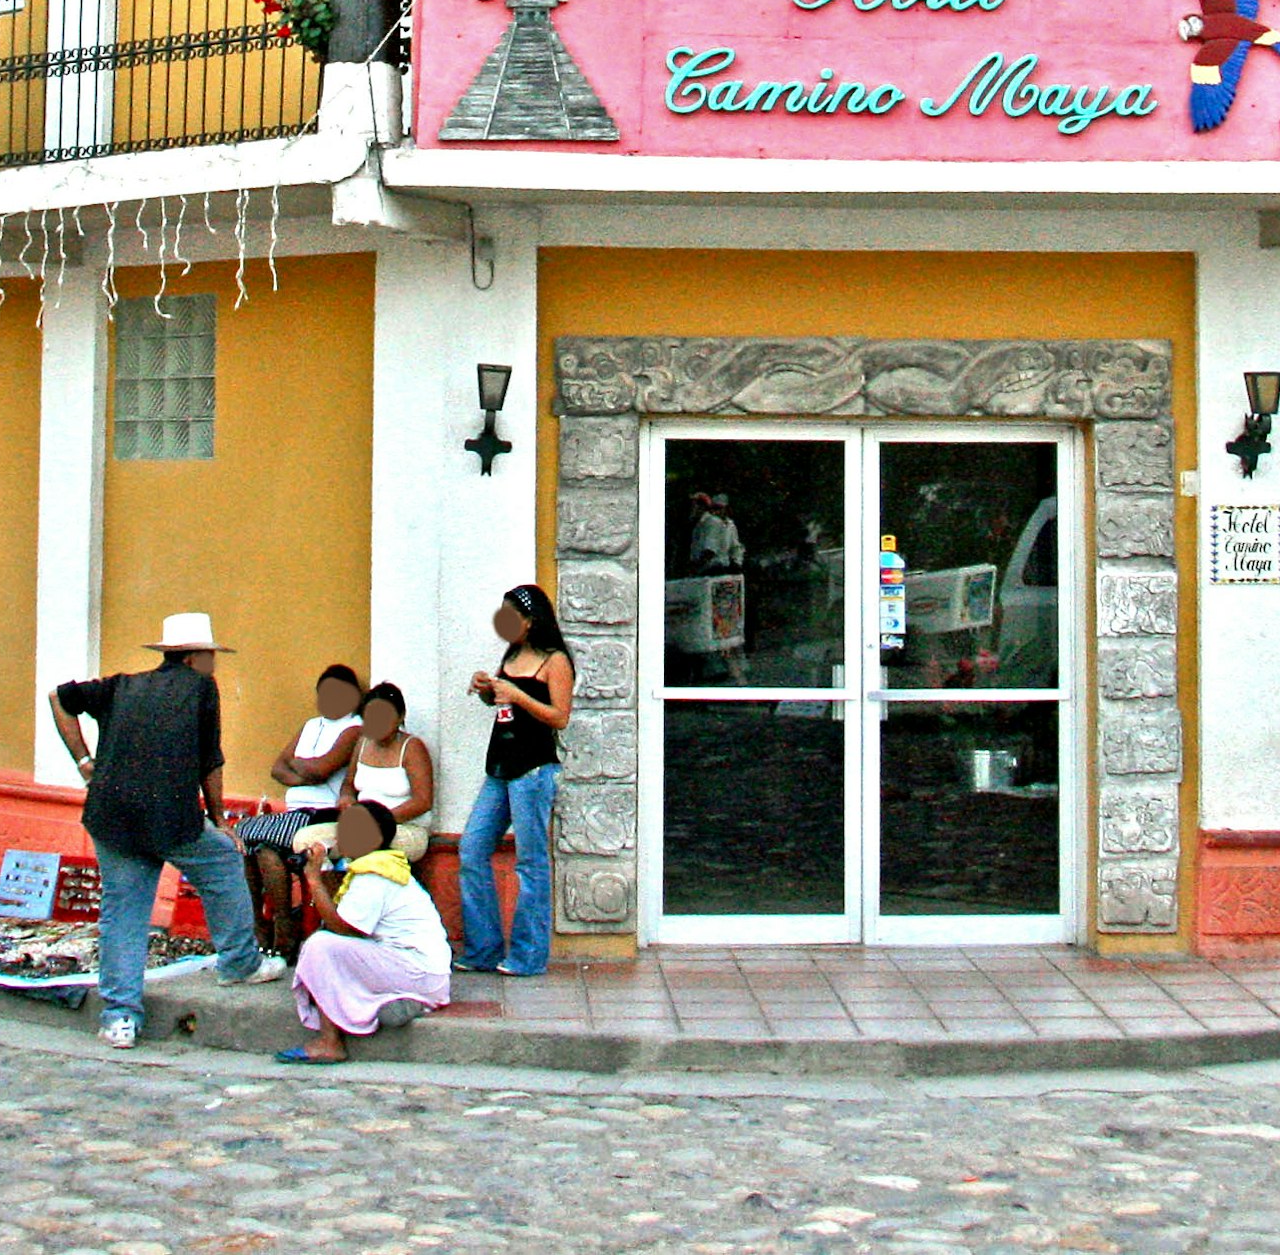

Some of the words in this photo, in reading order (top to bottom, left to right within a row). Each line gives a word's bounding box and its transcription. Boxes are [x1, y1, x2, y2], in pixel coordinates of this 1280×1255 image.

[666, 47, 903, 114] Camino
[921, 53, 1156, 135] Maya
[1222, 509, 1272, 533] Hotel
[1224, 552, 1272, 576] Maya
